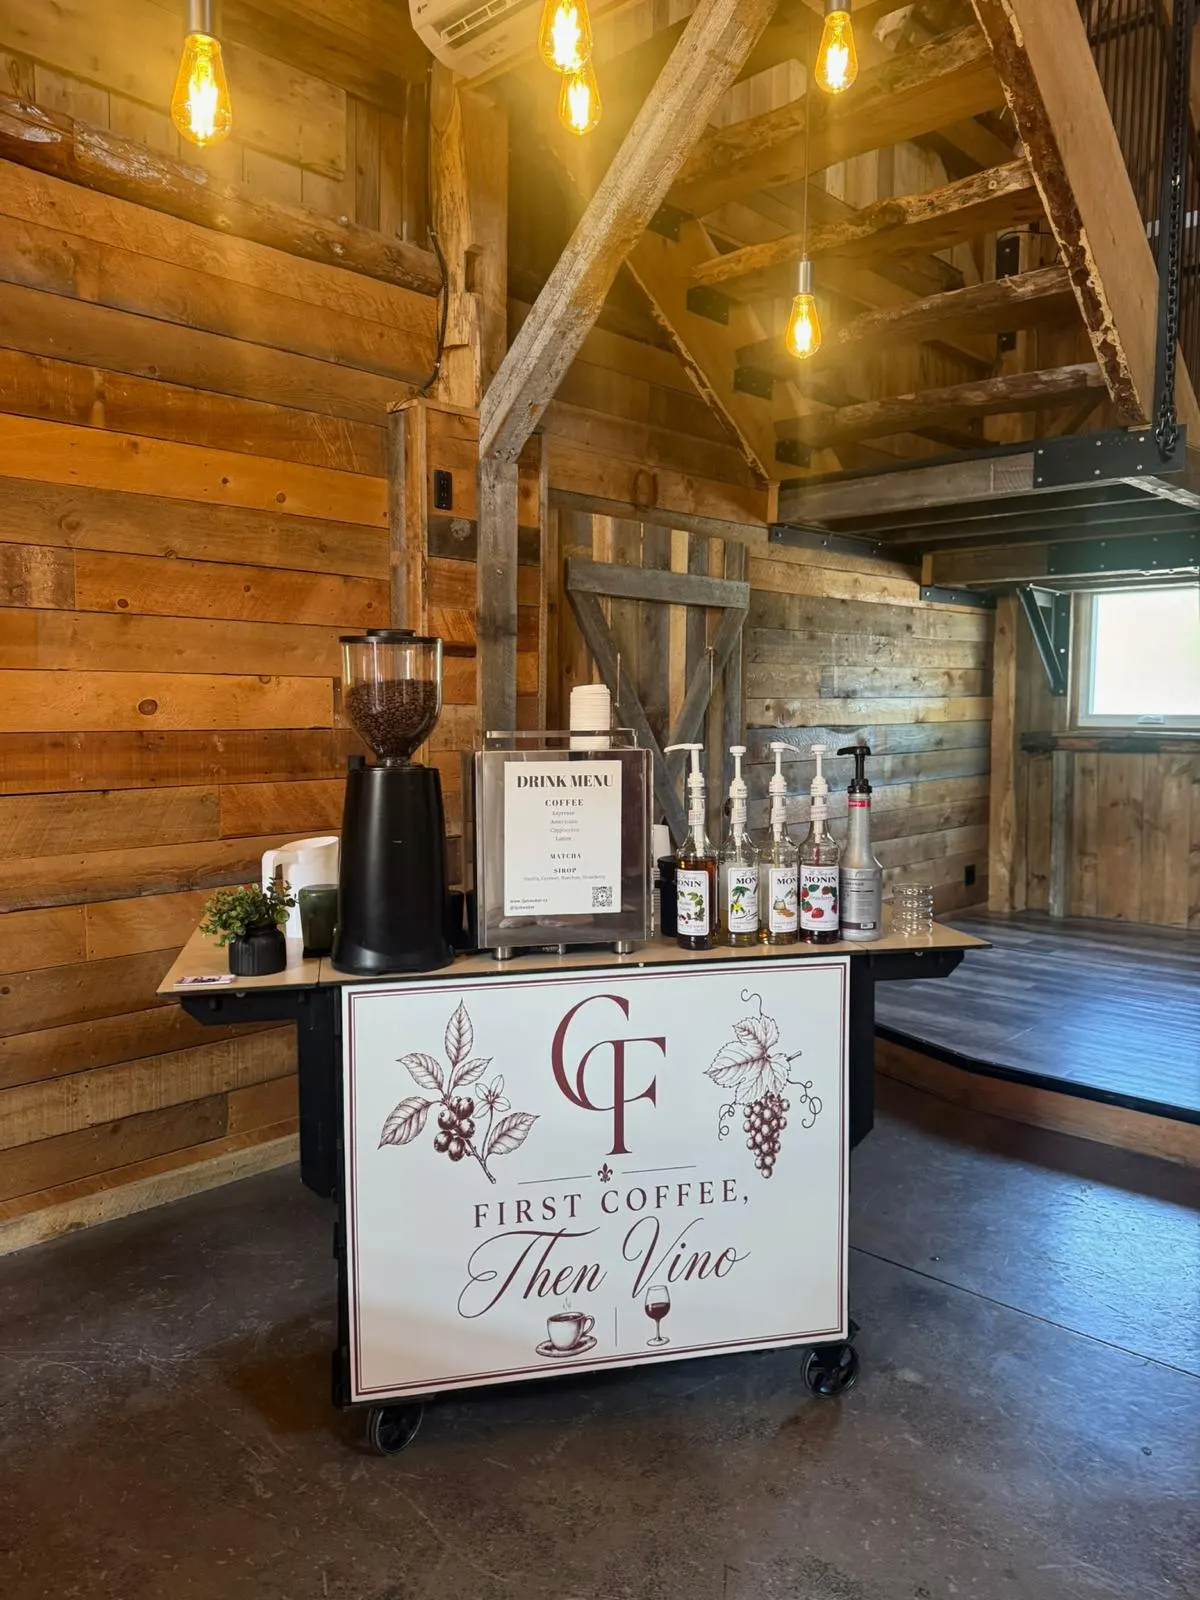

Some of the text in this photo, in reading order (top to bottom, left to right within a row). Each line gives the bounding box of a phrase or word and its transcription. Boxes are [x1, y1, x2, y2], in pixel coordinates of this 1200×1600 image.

[517, 774, 614, 788] DRINK MENU
[545, 799, 584, 807] COFFEE
[736, 877, 757, 885] MON
[777, 877, 797, 885] MON
[805, 875, 837, 883] MONIN
[678, 880, 702, 888] ONIN
[473, 1178, 749, 1228] FIRST COFFEE,
[457, 1216, 751, 1319] Then Vino
